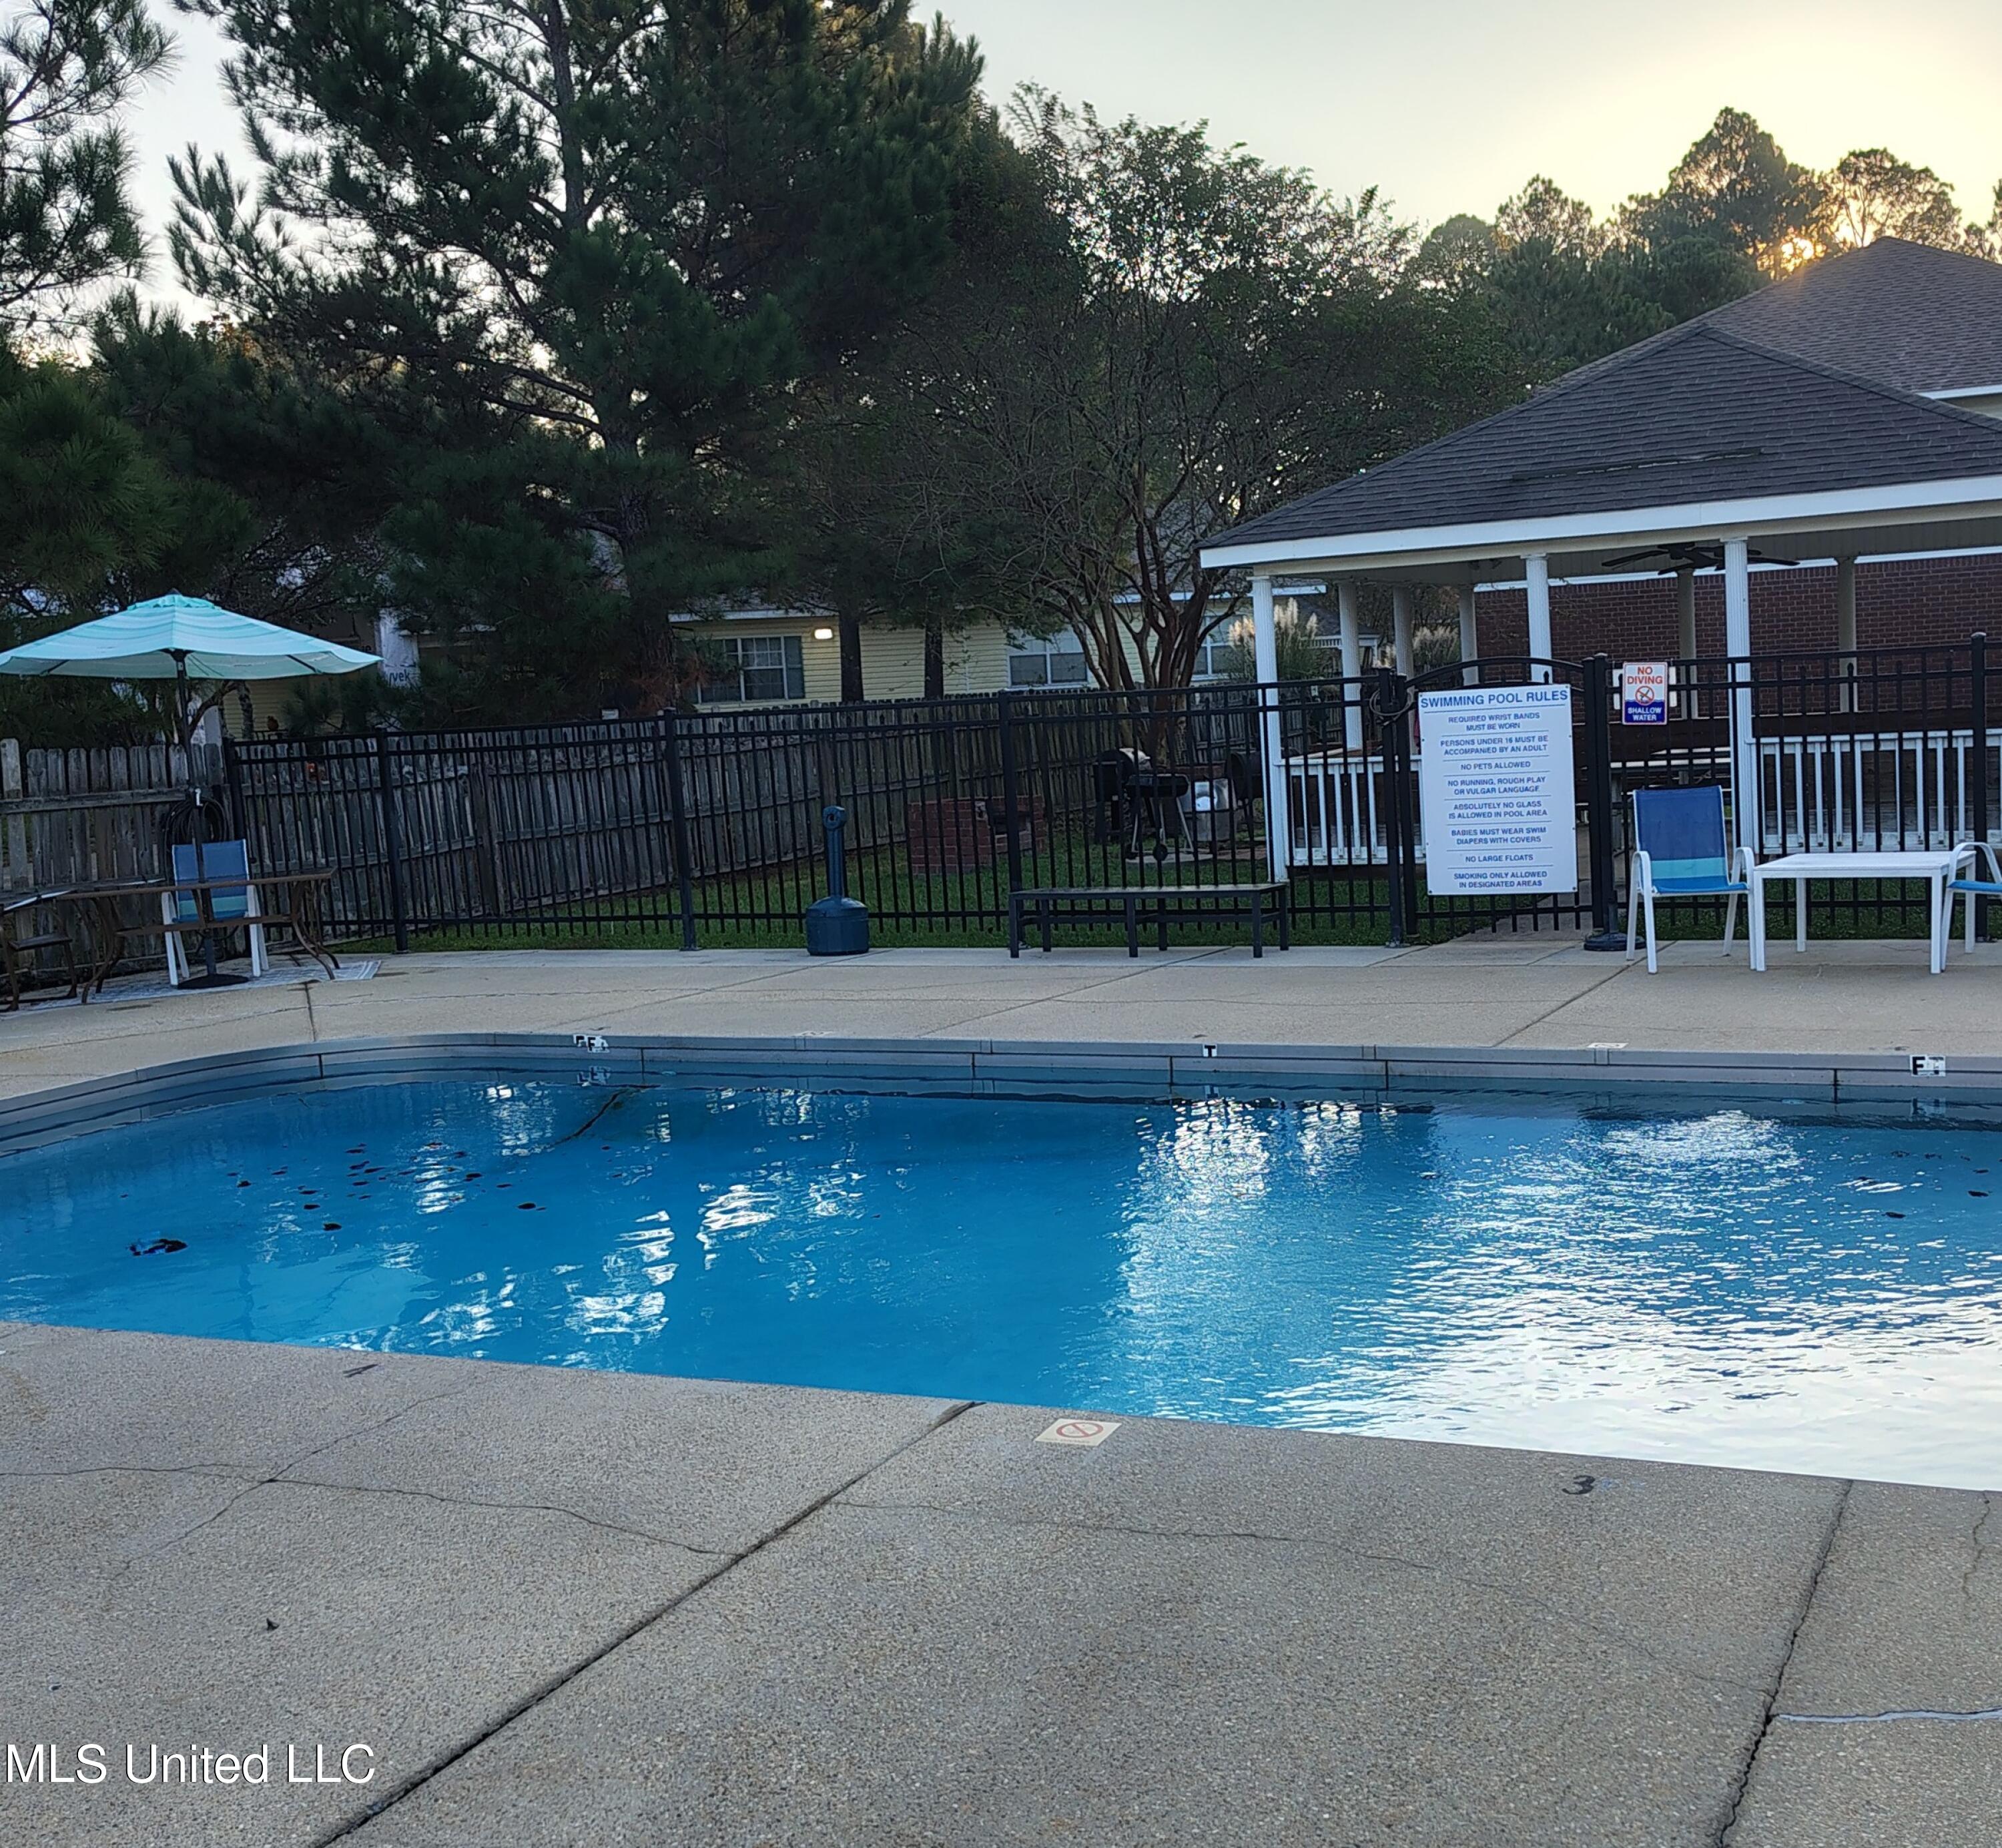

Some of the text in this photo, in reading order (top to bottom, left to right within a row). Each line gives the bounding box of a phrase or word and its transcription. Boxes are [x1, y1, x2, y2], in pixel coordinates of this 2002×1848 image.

[1638, 666, 1652, 675] NO
[1628, 675, 1663, 684] DIVING
[1421, 689, 1568, 708] SWIMMING POOL RULES
[1449, 715, 1486, 723] REQUIRED
[1488, 713, 1512, 721] WRIST
[1441, 739, 1475, 747] PERSONS
[1444, 747, 1496, 755] ACCOMPANIED
[1494, 761, 1530, 769] ALLOWED
[1498, 786, 1540, 794] LANGUAGE
[1562, 1474, 1596, 1495] 3
